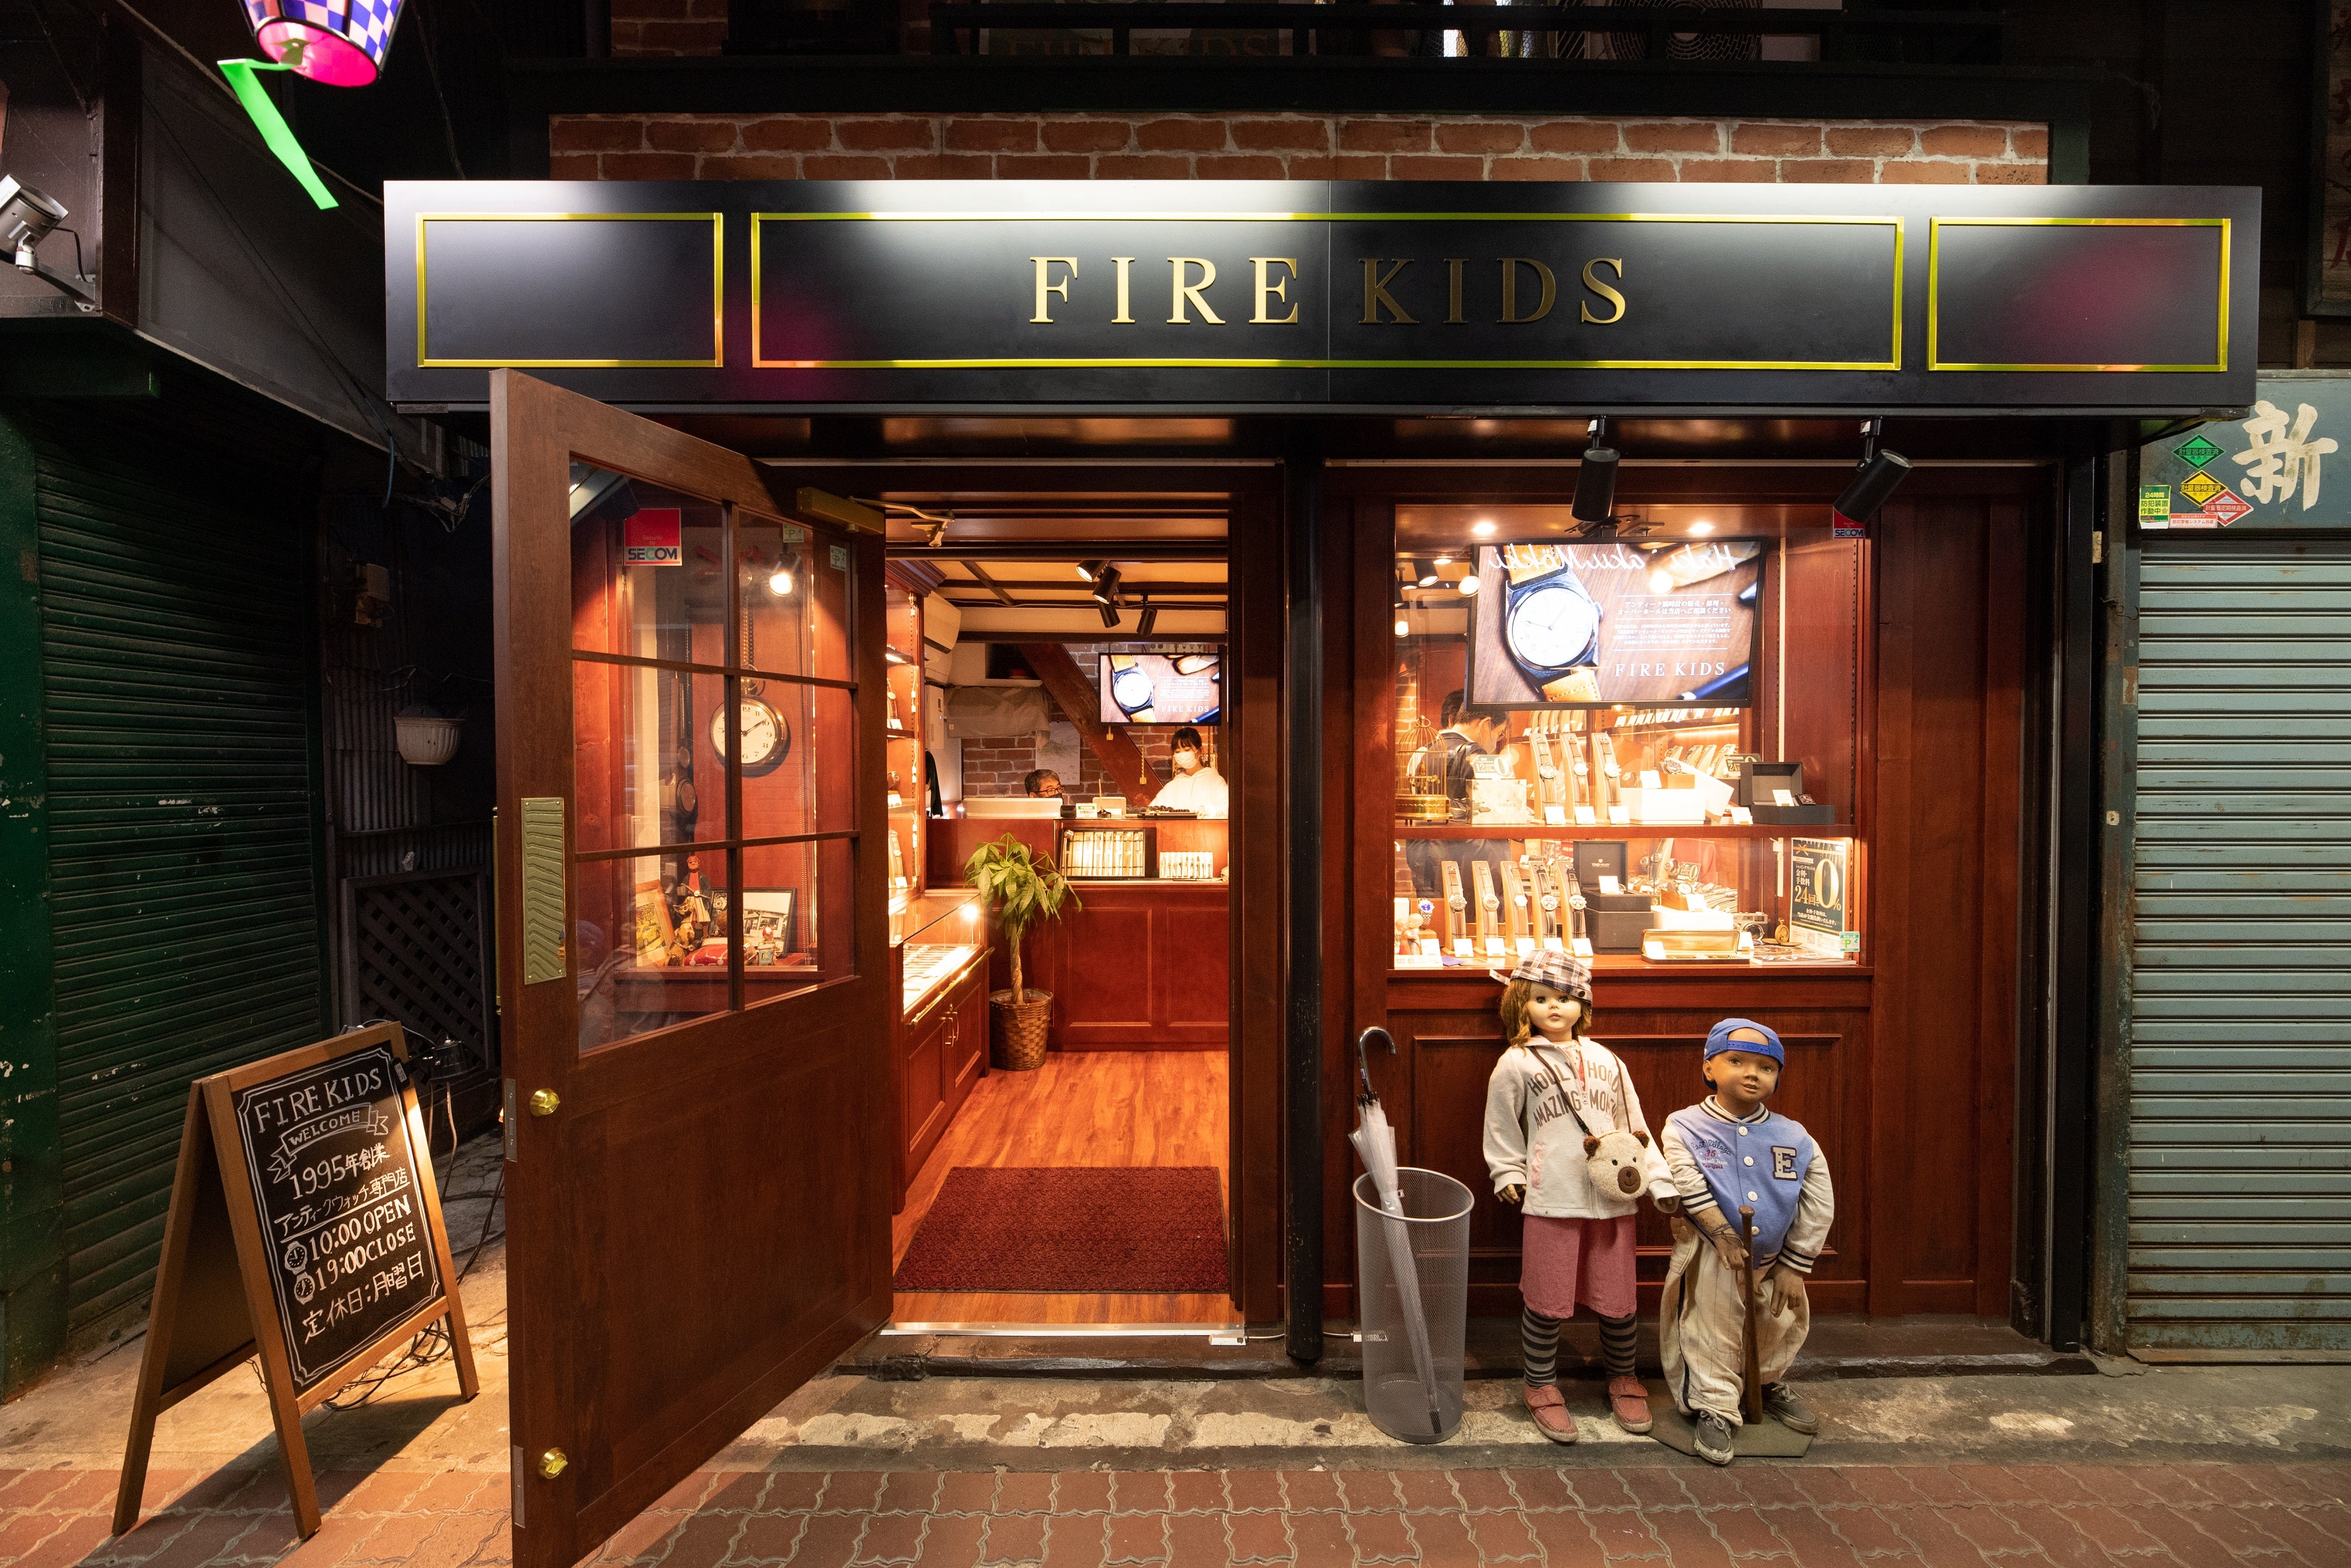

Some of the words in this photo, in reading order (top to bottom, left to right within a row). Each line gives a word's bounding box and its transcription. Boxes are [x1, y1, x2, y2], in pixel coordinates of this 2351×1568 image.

[1029, 256, 1299, 325] FIRE
[1358, 257, 1626, 325] KIDS
[2232, 400, 2339, 512] 新
[628, 547, 677, 561] SECOM
[1614, 663, 1665, 677] FIRE
[1674, 662, 1725, 676] KIDS
[1796, 877, 1811, 886] 手数料
[254, 1085, 322, 1133] FIRE
[326, 1068, 383, 1109] KIDS
[288, 1110, 361, 1147] WELCOME
[289, 1142, 391, 1201] 1995年創業
[1770, 1145, 1798, 1181] E
[274, 1166, 409, 1237] アンティークウォッチ専門店
[309, 1217, 362, 1262] 10:00
[363, 1194, 413, 1235] OPEN
[316, 1245, 367, 1291] 19:00
[365, 1222, 416, 1263] CLOSE
